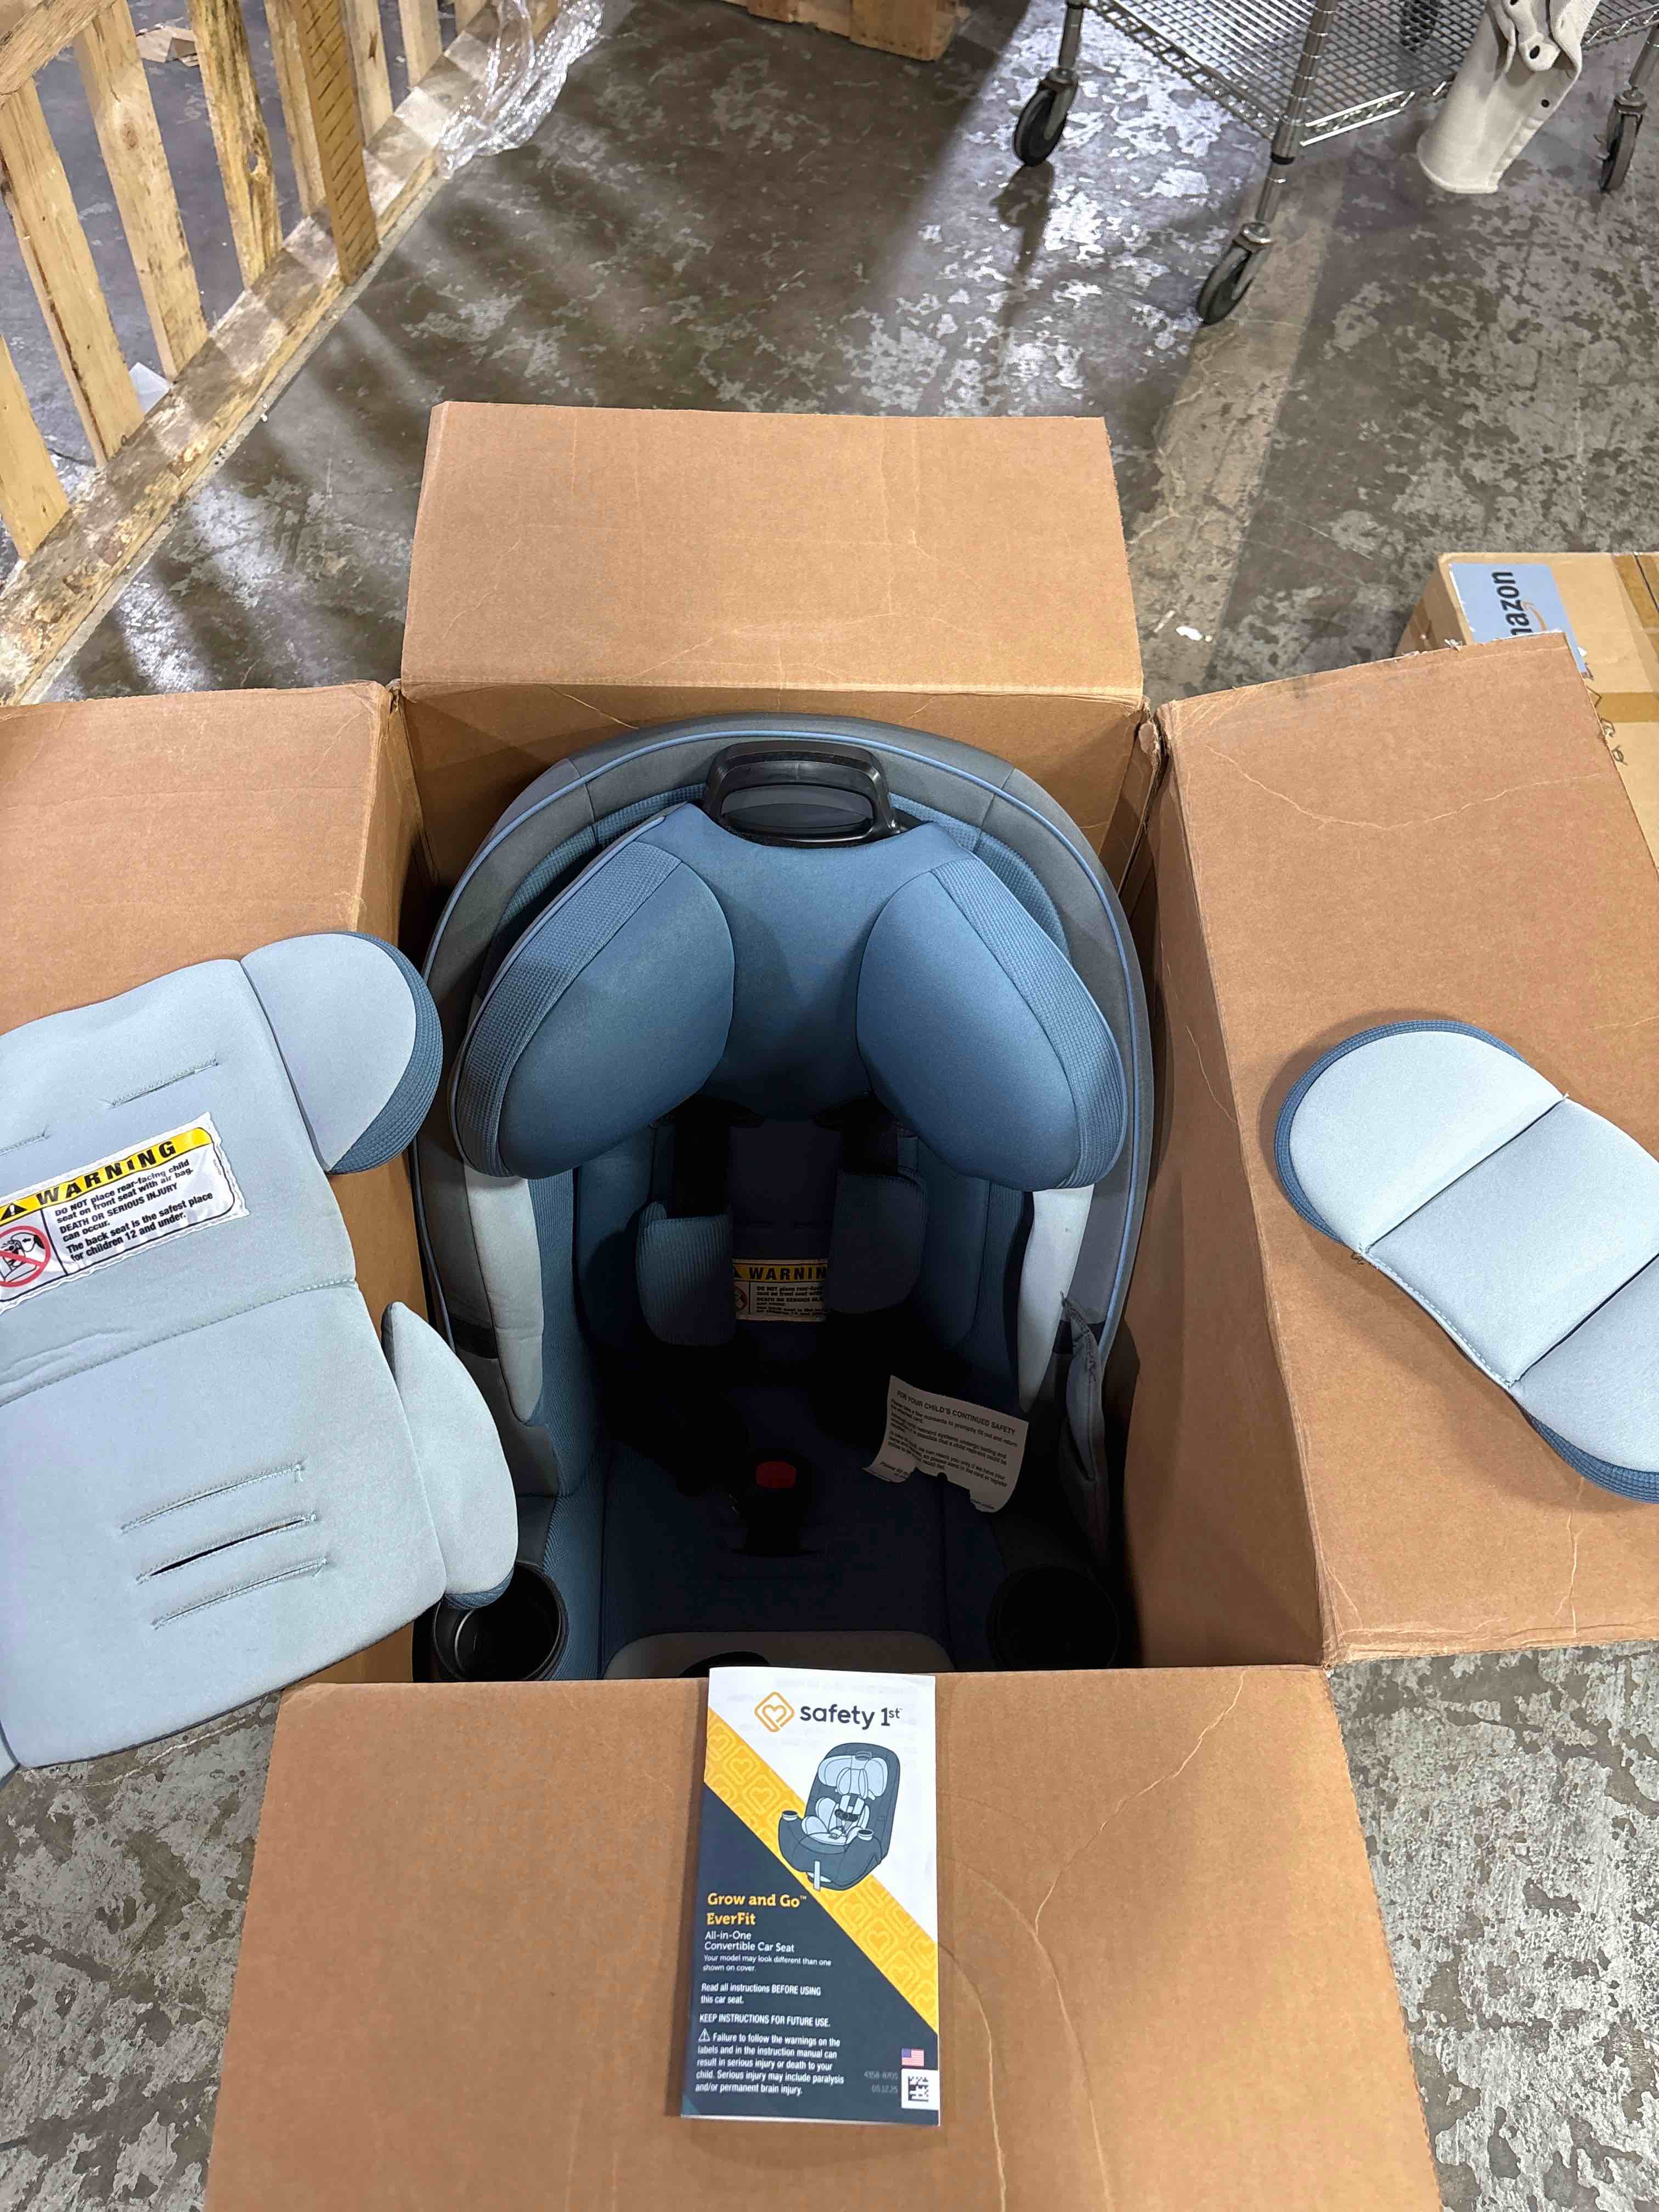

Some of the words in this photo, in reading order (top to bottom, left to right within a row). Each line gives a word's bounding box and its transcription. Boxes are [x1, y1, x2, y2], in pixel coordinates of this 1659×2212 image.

[1491, 571, 1532, 636] azon
[36, 1141, 176, 1205] WARNING
[54, 1207, 68, 1217] DO
[70, 1199, 87, 1211] NOT
[91, 1190, 115, 1204] place
[117, 1170, 166, 1194] rear-facing
[168, 1159, 189, 1173] child
[57, 1212, 77, 1223] seat
[80, 1207, 91, 1216] on
[93, 1198, 116, 1210] front
[117, 1189, 137, 1202] seat
[138, 1179, 157, 1193] with
[161, 1176, 171, 1184] air
[175, 1168, 193, 1179] bag.
[59, 1217, 89, 1234] DEATH
[92, 1212, 105, 1222] OR
[107, 1199, 145, 1217] SERIOUS
[146, 1182, 177, 1200] INJURY
[66, 1243, 83, 1254] The
[86, 1232, 109, 1246] back
[110, 1223, 131, 1236] seat
[132, 1219, 140, 1228] is
[142, 1211, 157, 1223] the
[159, 1201, 187, 1216] safest
[188, 1192, 213, 1207] place
[63, 1233, 80, 1242] can
[82, 1220, 110, 1234] occur.
[71, 1252, 83, 1262] for
[86, 1236, 124, 1257] children
[125, 1229, 137, 1240] 12
[139, 1222, 156, 1235] and
[158, 1211, 186, 1227] under.
[749, 1267, 826, 1280] WARNIN
[897, 1390, 907, 1401] FOR
[908, 1396, 923, 1407] YOUR
[952, 1410, 990, 1427] CONTINUED
[991, 1421, 1015, 1435] SAFETY
[799, 1704, 874, 1730] safety
[707, 1893, 745, 1905] Grow
[748, 1894, 776, 1906] and
[707, 1912, 755, 1925] EverFit
[704, 1930, 752, 1940] All-in-One
[704, 1941, 755, 1951] Convertible
[758, 1942, 773, 1951] Car
[776, 1943, 794, 1953] Seat
[774, 1956, 801, 1965] different
[803, 1957, 817, 1965] than
[701, 1983, 719, 1991] Read
[720, 1983, 728, 1991] all
[730, 1983, 770, 1993] instructions
[771, 1984, 798, 1995] BEFORE
[800, 1986, 821, 1996] USING
[701, 1995, 713, 2004] this
[727, 1996, 744, 2004] seat.
[699, 2013, 717, 2023] KEEP
[719, 2013, 769, 2024] INSTRUCTIONS
[771, 2015, 785, 2025] FOR
[787, 2016, 813, 2026] FUTURE
[815, 2017, 831, 2027] USE.
[713, 2032, 737, 2041] Failure
[739, 2033, 746, 2042] to
[748, 2033, 769, 2043] follow
[771, 2034, 782, 2044] the
[785, 2035, 816, 2047] warnings
[829, 2038, 840, 2047] the
[698, 2045, 718, 2054] labels
[720, 2046, 732, 2054] and
[744, 2046, 755, 2055] the
[757, 2046, 794, 2056] instruction
[797, 2049, 822, 2058] manual
[824, 2051, 837, 2059] can
[697, 2057, 716, 2067] result
[719, 2058, 725, 2067] in
[727, 2058, 753, 2067] serious
[755, 2059, 775, 2069] injury
[786, 2060, 806, 2069] death
[808, 2061, 815, 2070] to
[816, 2062, 833, 2072] your
[696, 2069, 715, 2079] child.
[717, 2070, 744, 2079] Serious
[746, 2071, 766, 2081] injury
[768, 2073, 783, 2083] may
[785, 2073, 811, 2082] include
[812, 2074, 844, 2085] paralysis
[695, 2083, 718, 2092] and/or
[720, 2084, 759, 2093] permanent
[760, 2084, 779, 2094] brain
[781, 2085, 803, 2096] injury.
